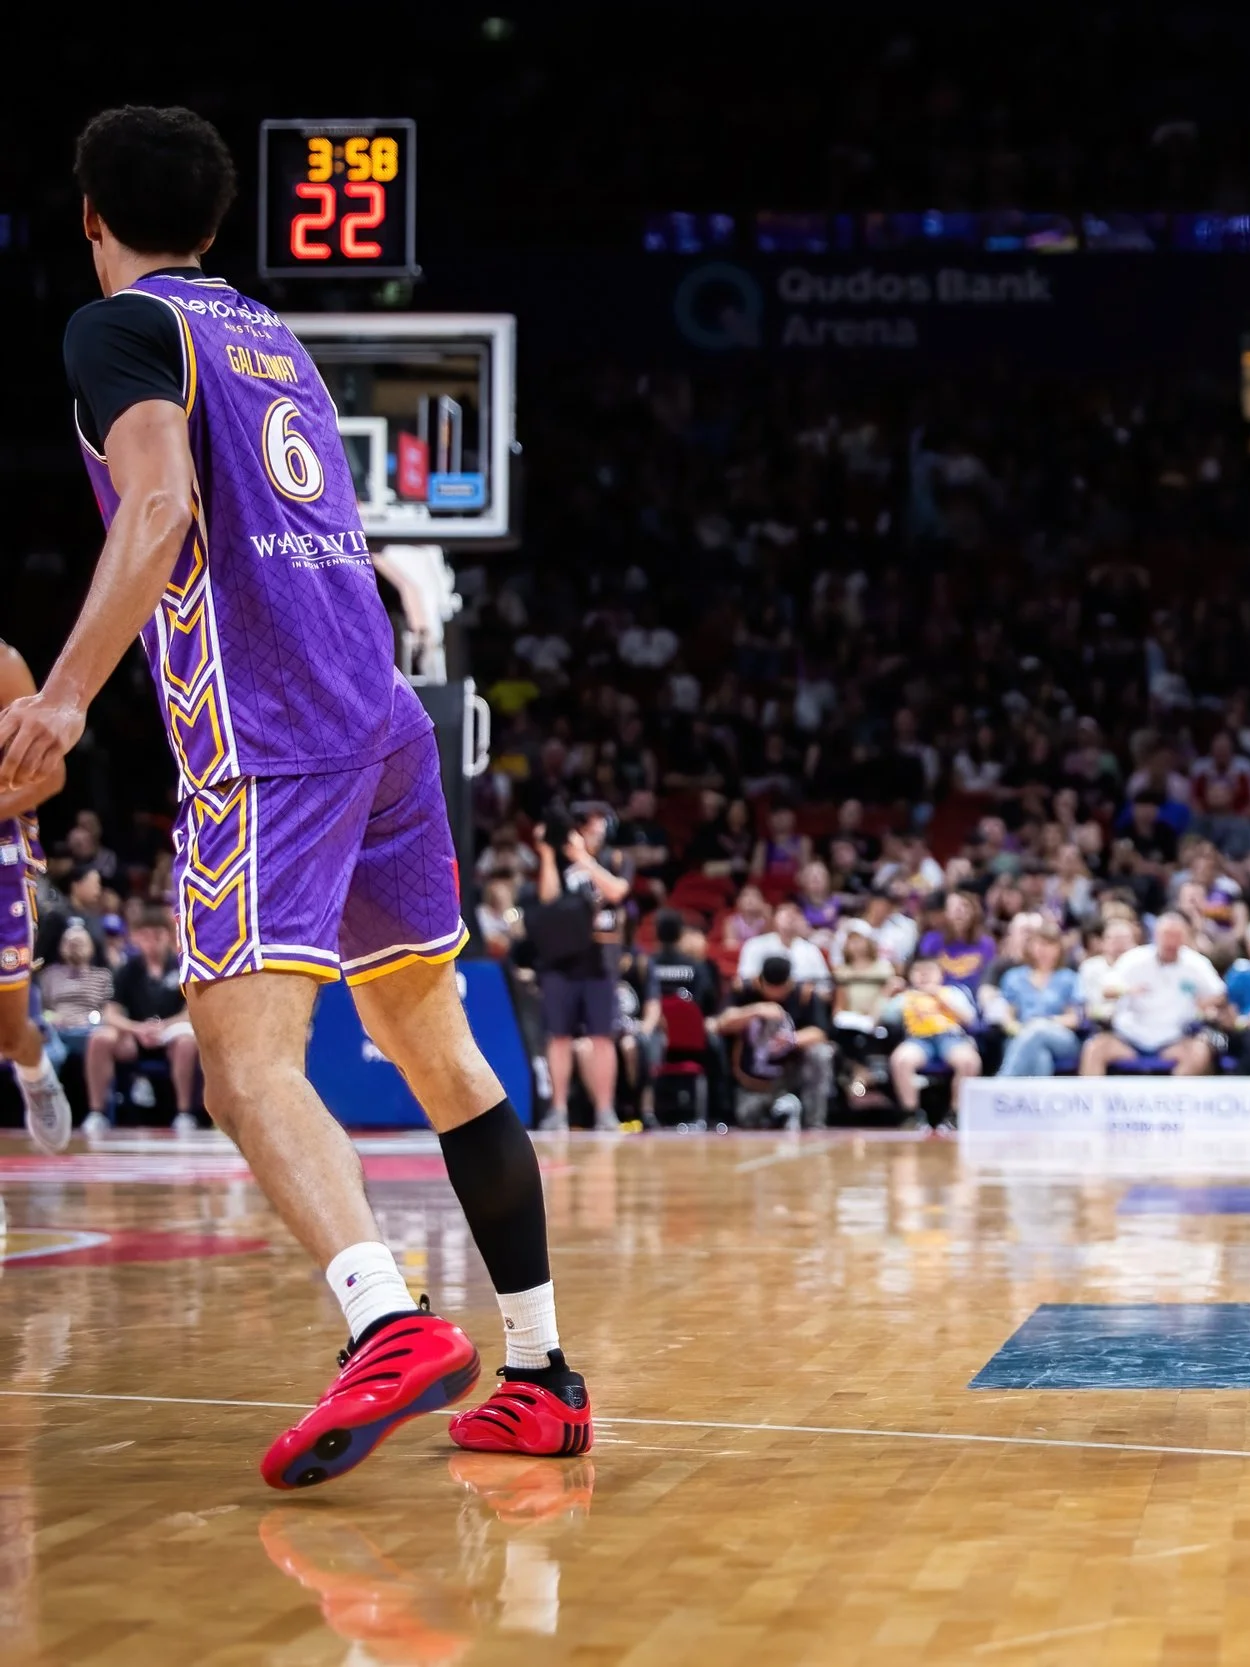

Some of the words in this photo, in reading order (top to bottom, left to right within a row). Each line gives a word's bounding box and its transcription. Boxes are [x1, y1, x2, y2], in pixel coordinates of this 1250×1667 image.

[308, 137, 399, 182] 3:58
[291, 182, 385, 259] 22
[777, 266, 930, 304] Qudos
[936, 266, 1054, 304] Bank
[781, 313, 918, 348] Arena
[262, 397, 325, 503] 6
[994, 1092, 1093, 1118] SALON
